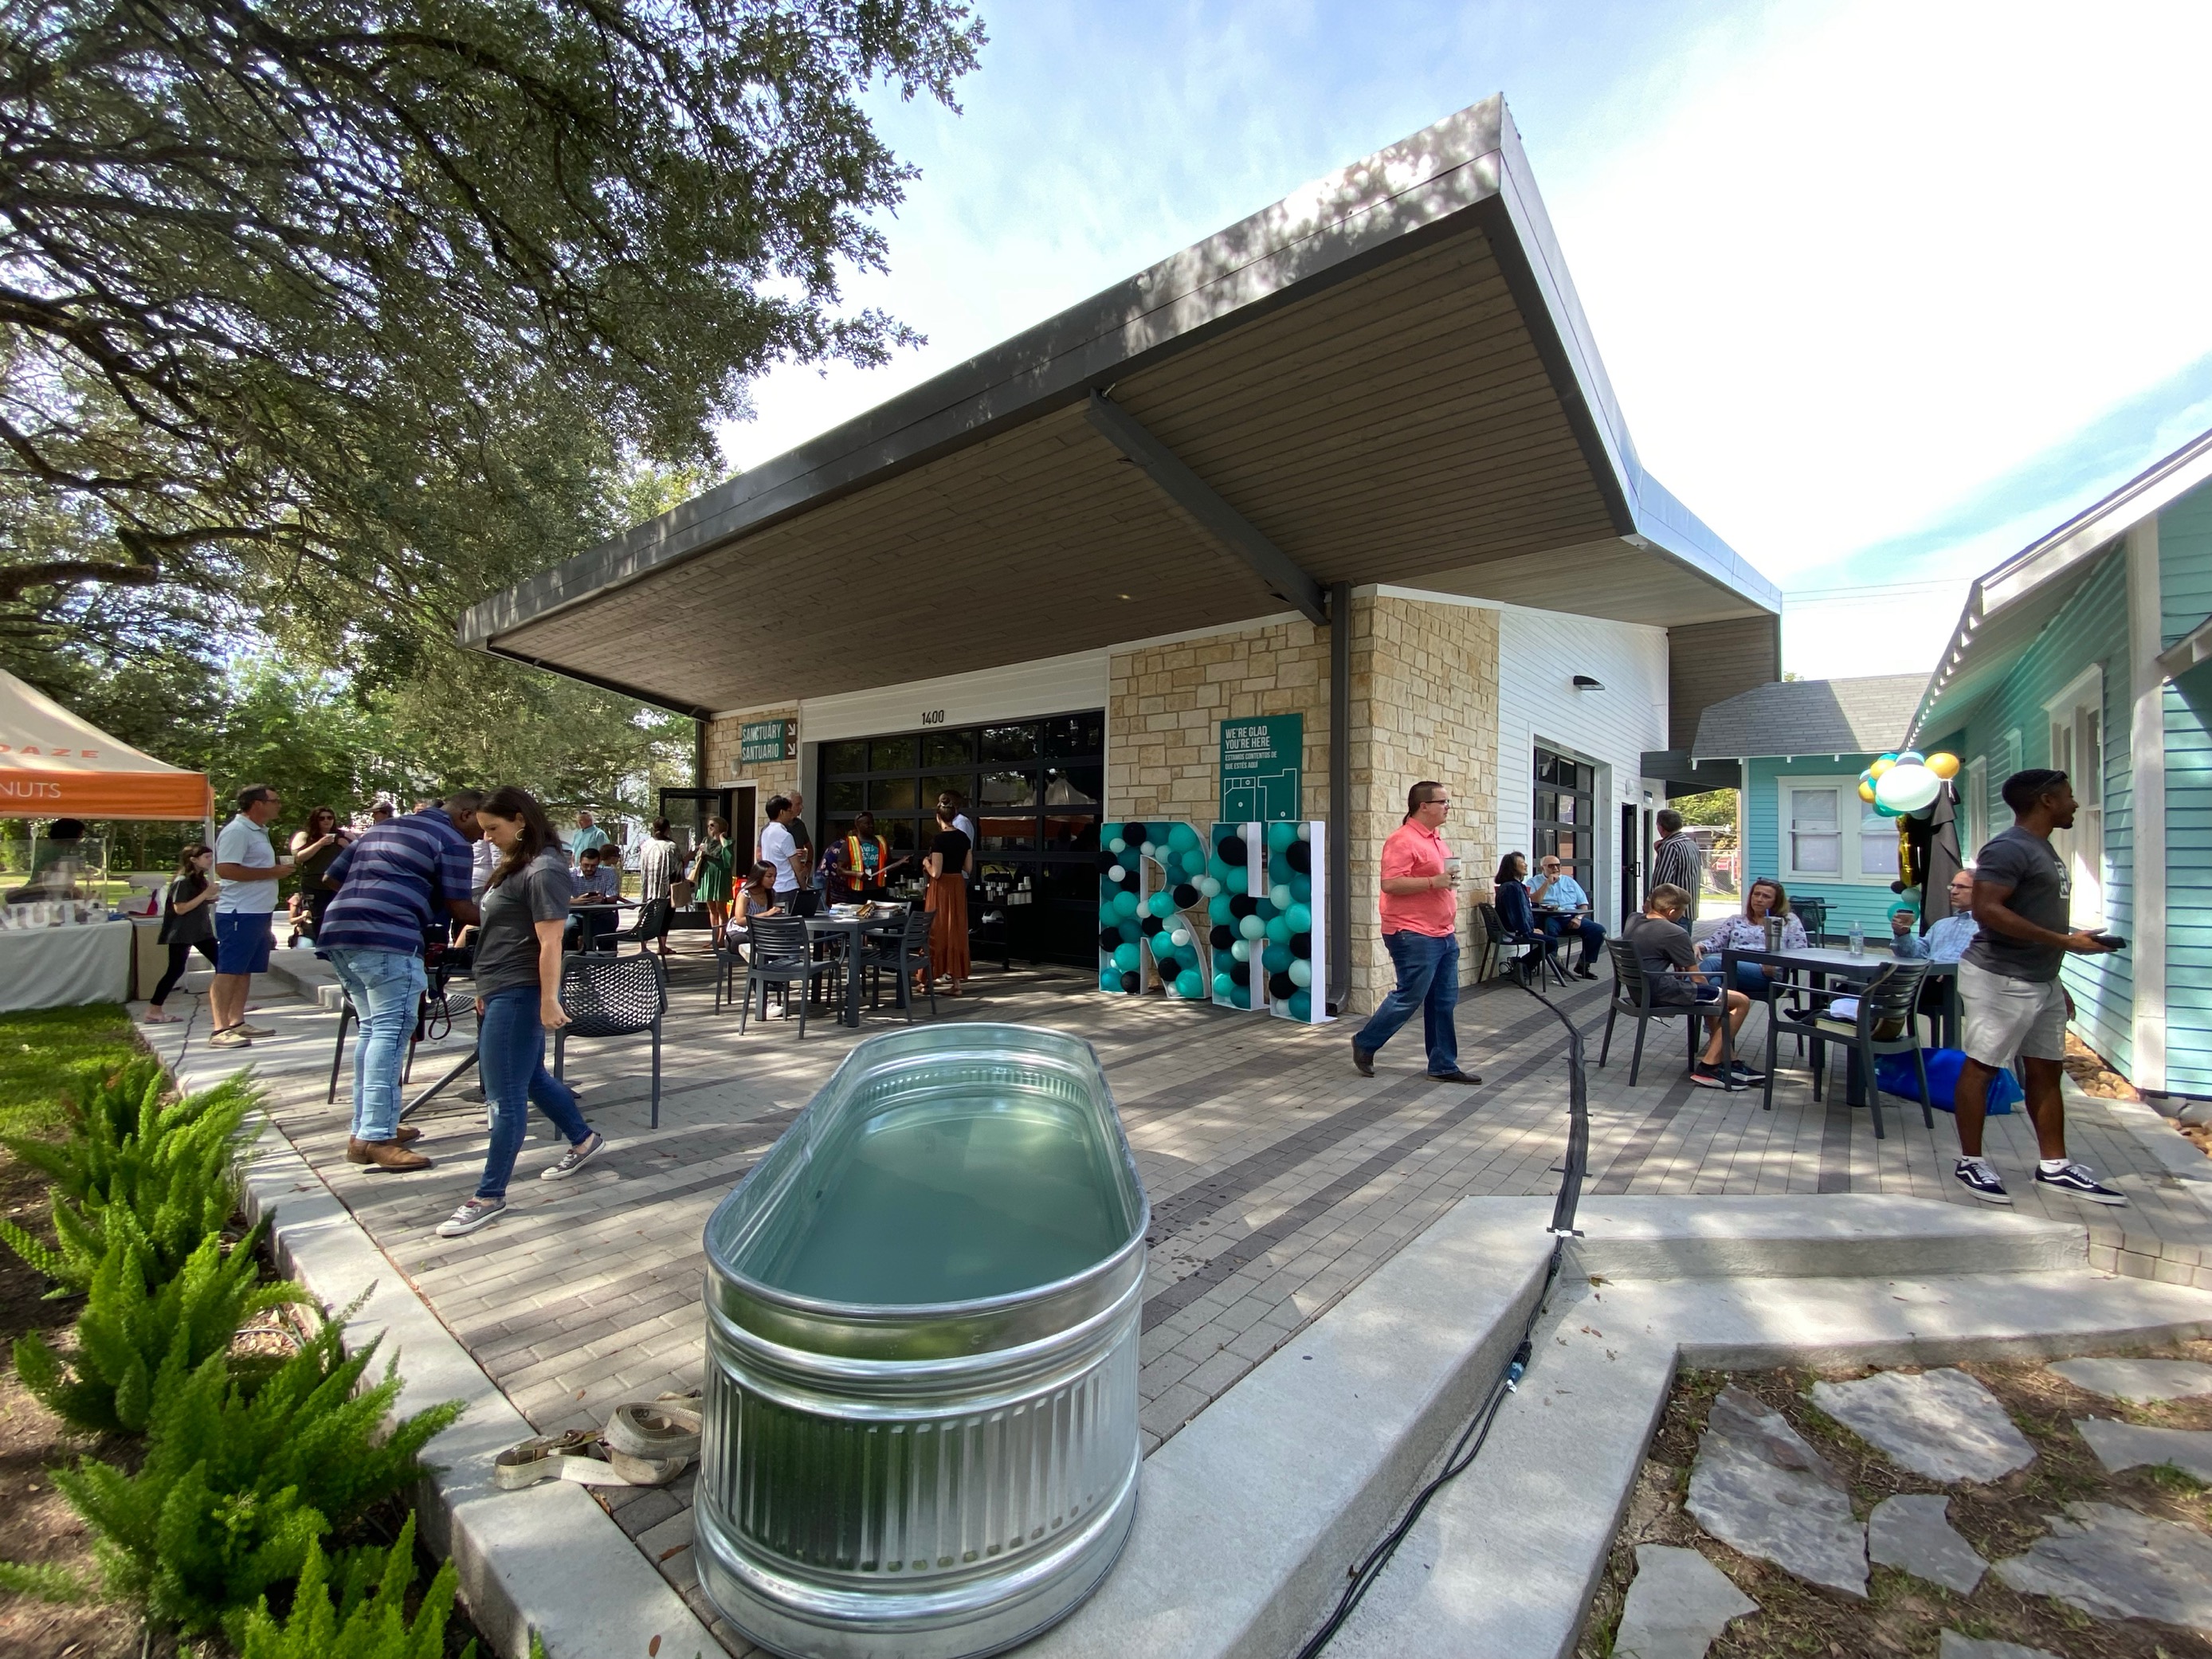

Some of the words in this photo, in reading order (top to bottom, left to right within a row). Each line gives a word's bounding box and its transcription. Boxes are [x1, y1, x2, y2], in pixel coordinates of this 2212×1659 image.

[922, 710, 944, 725] 1400
[742, 723, 782, 743] SANCTUARY
[1226, 728, 1247, 739] WE'RE
[1249, 726, 1267, 736] GLAD
[1226, 738, 1250, 749] YOU'RE
[1251, 736, 1270, 747] HERE
[742, 743, 779, 761] SANTUARIO
